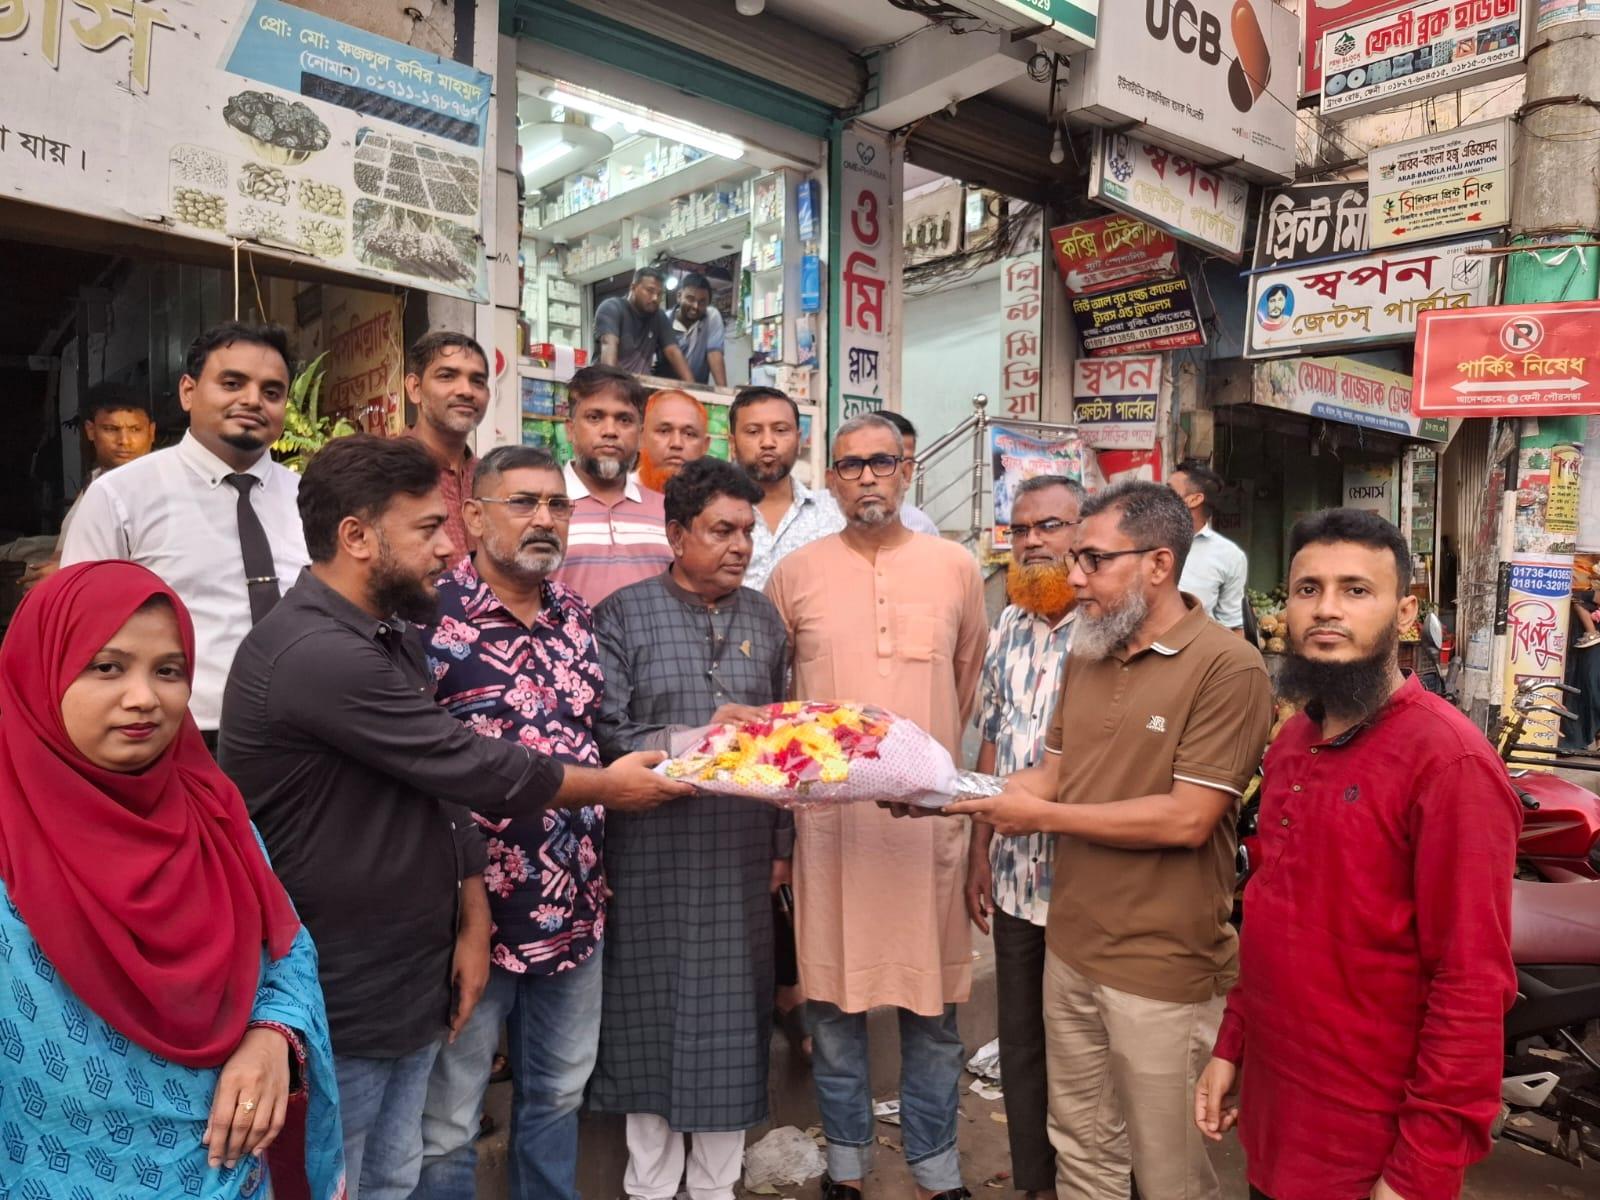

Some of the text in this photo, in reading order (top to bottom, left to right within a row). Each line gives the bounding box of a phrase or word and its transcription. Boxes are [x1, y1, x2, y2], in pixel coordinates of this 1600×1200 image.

[1145, 0, 1222, 66] UCB
[1365, 10, 1415, 57] ফেনী
[1417, 7, 1451, 46] ব্লক
[395, 57, 433, 85] কবির
[438, 72, 482, 101] মাহমুদ
[1446, 163, 1463, 174] HAJJ
[1463, 155, 1497, 169] AVIATION
[1266, 194, 1331, 260] প্রিন্ট
[1091, 295, 1112, 311] আল
[1149, 279, 1187, 296] কাফেলা
[1296, 255, 1441, 300] স্বপন
[848, 346, 879, 385] প্লাস
[1080, 358, 1157, 395] স্বপন
[1299, 361, 1338, 397] মেসার্স
[1457, 353, 1586, 378] পার্কিং নিষেধ
[1115, 397, 1156, 422] পার্লার
[1520, 392, 1540, 403] ফেনী
[1349, 481, 1388, 499] মেসার্স
[1507, 599, 1563, 669] বিন্দু
